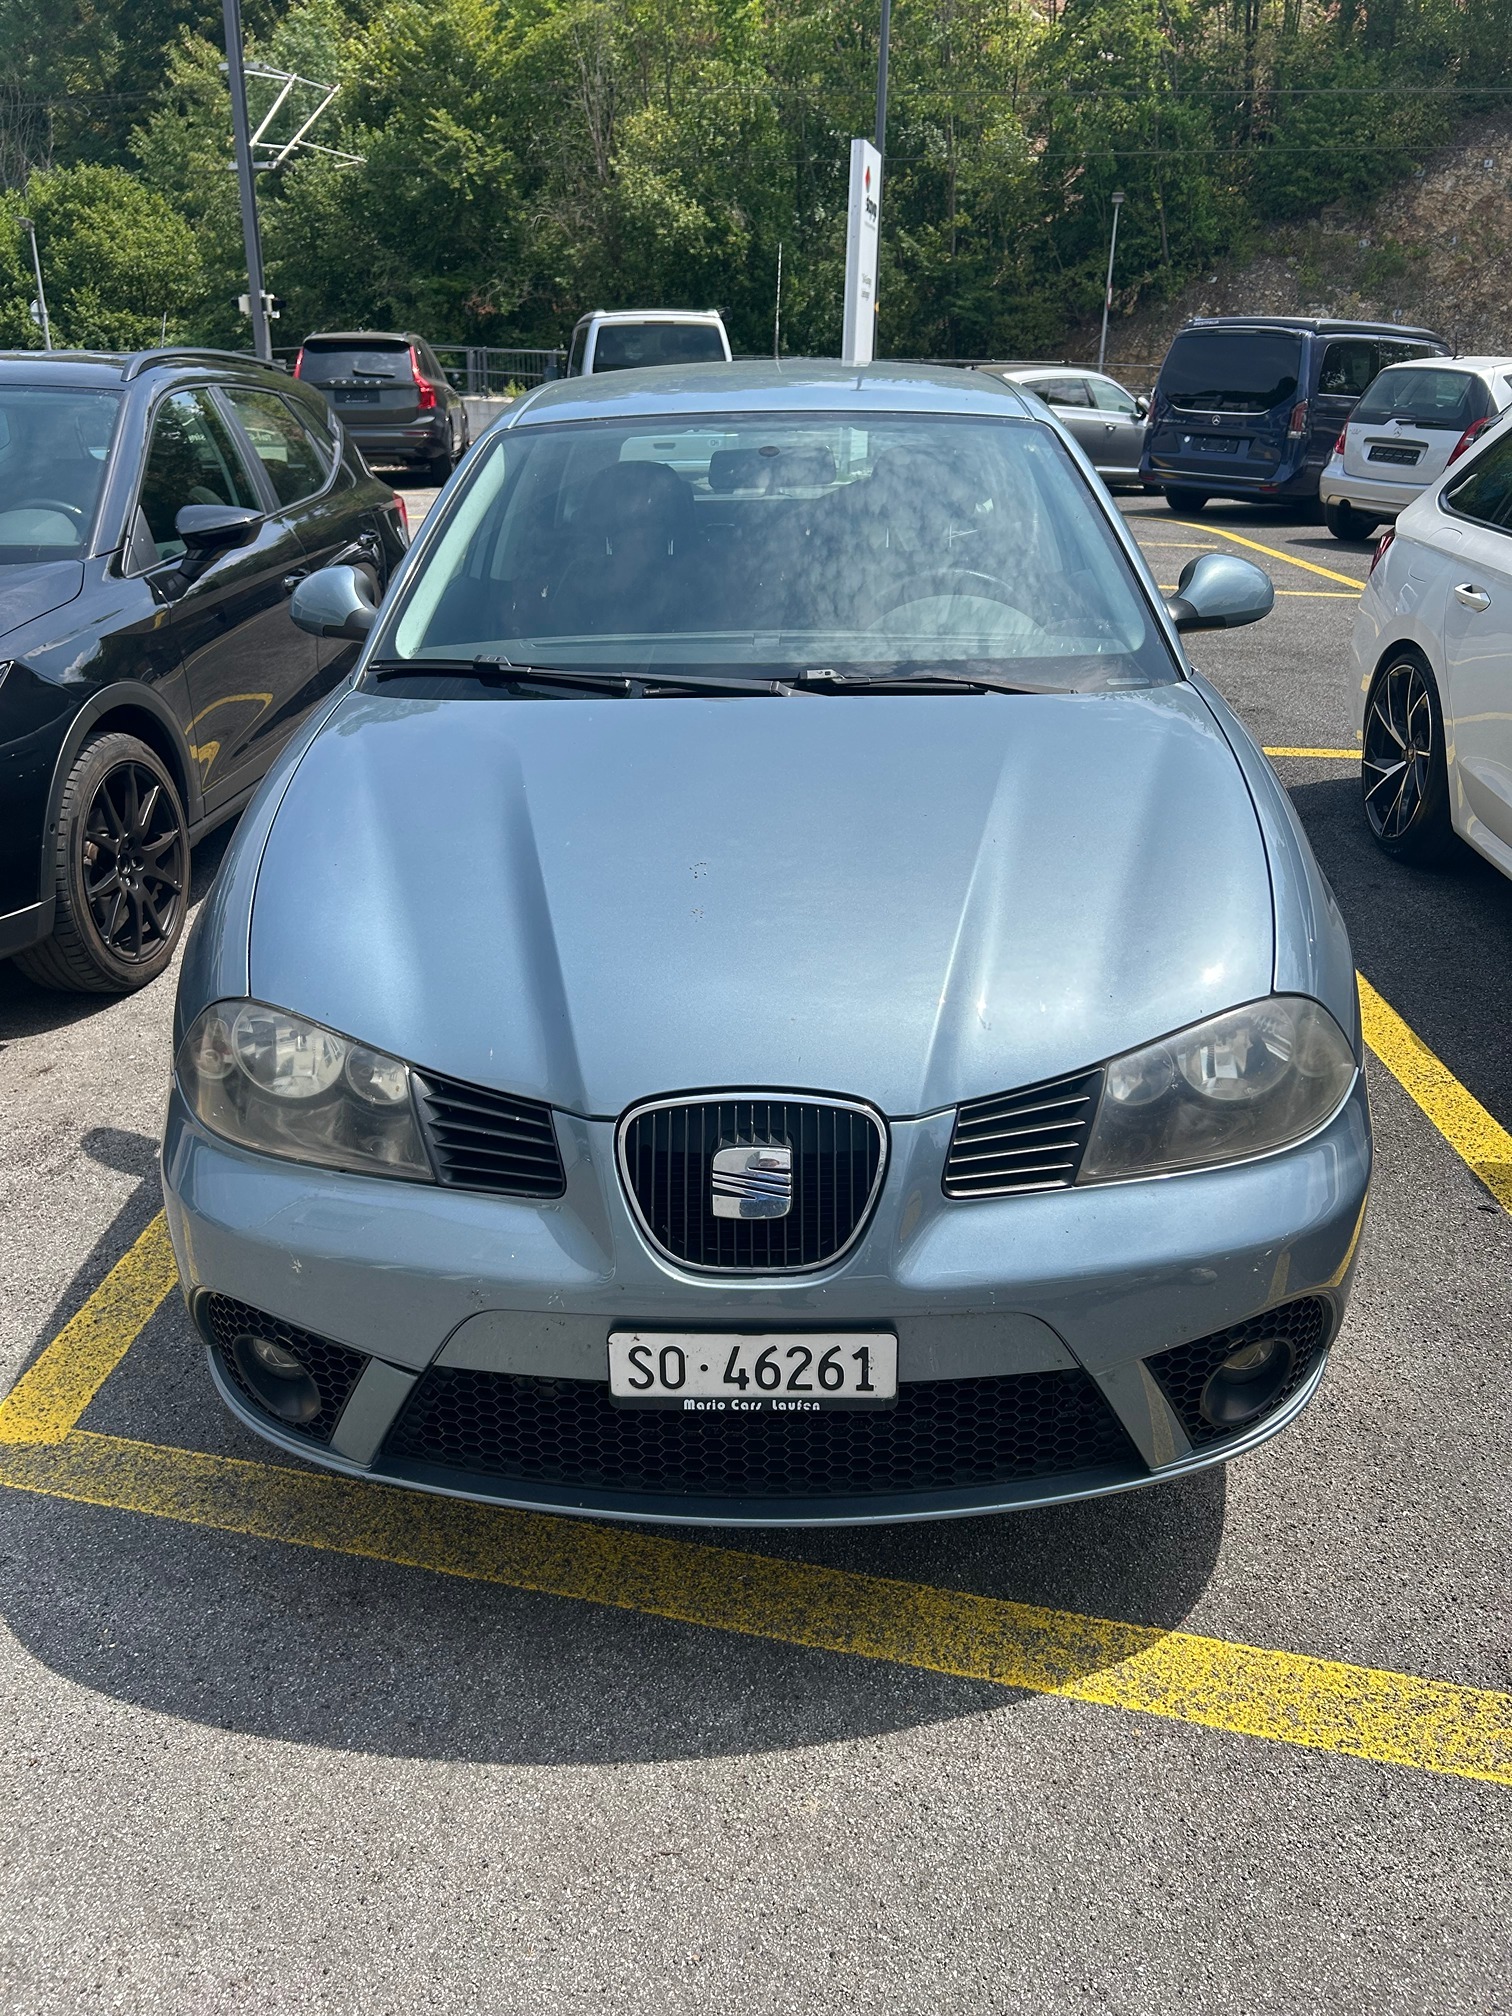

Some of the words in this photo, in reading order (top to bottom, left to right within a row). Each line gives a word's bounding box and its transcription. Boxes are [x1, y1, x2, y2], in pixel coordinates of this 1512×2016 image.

[628, 1346, 686, 1389] SO
[723, 1345, 875, 1391] 46261
[683, 1399, 726, 1411] Mario
[731, 1399, 762, 1411] Cars
[772, 1399, 821, 1411] Laufen
